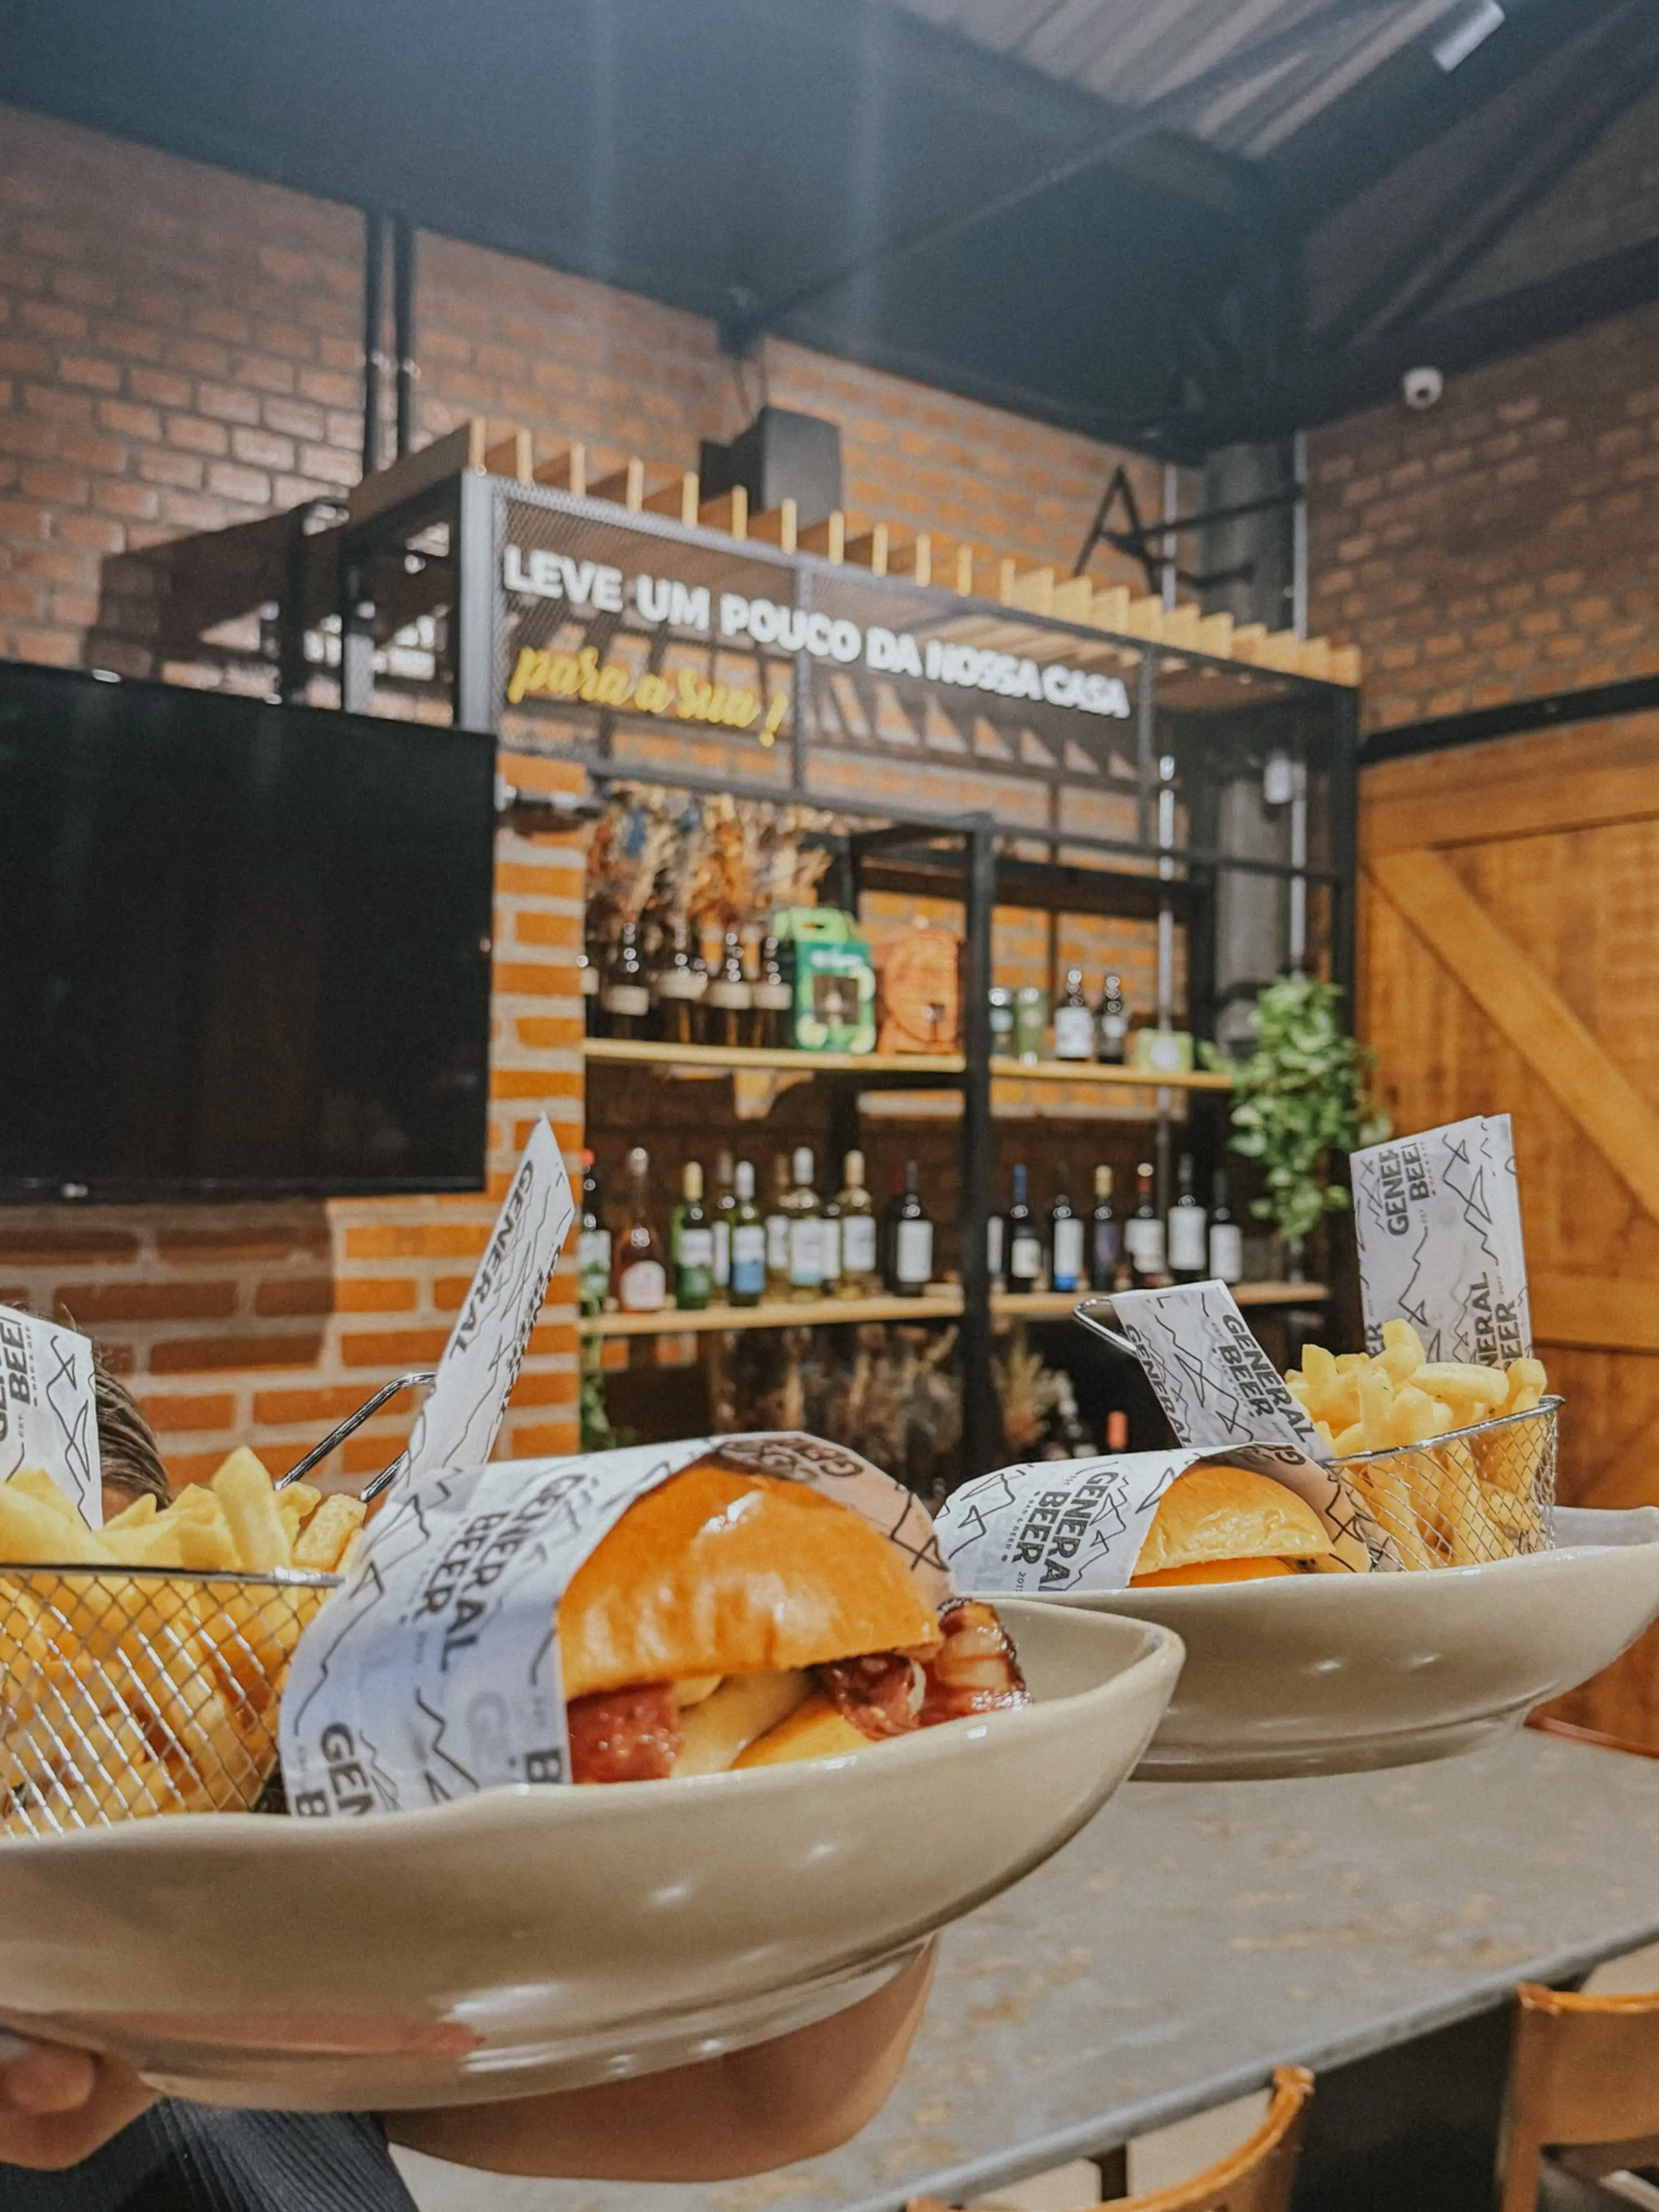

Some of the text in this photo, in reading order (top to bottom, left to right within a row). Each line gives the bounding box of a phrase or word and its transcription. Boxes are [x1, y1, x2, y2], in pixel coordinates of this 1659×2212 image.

[504, 544, 1130, 718] LEVE UM POUCO DA NOSSA CASA
[508, 646, 633, 706] para
[1400, 1142, 1429, 1202] BEE
[1, 1318, 30, 1405] BEE
[1218, 1345, 1274, 1417] BEER
[1223, 1314, 1316, 1443] GENERAL
[412, 1510, 512, 1620] BEER
[1012, 1491, 1072, 1564] BEER
